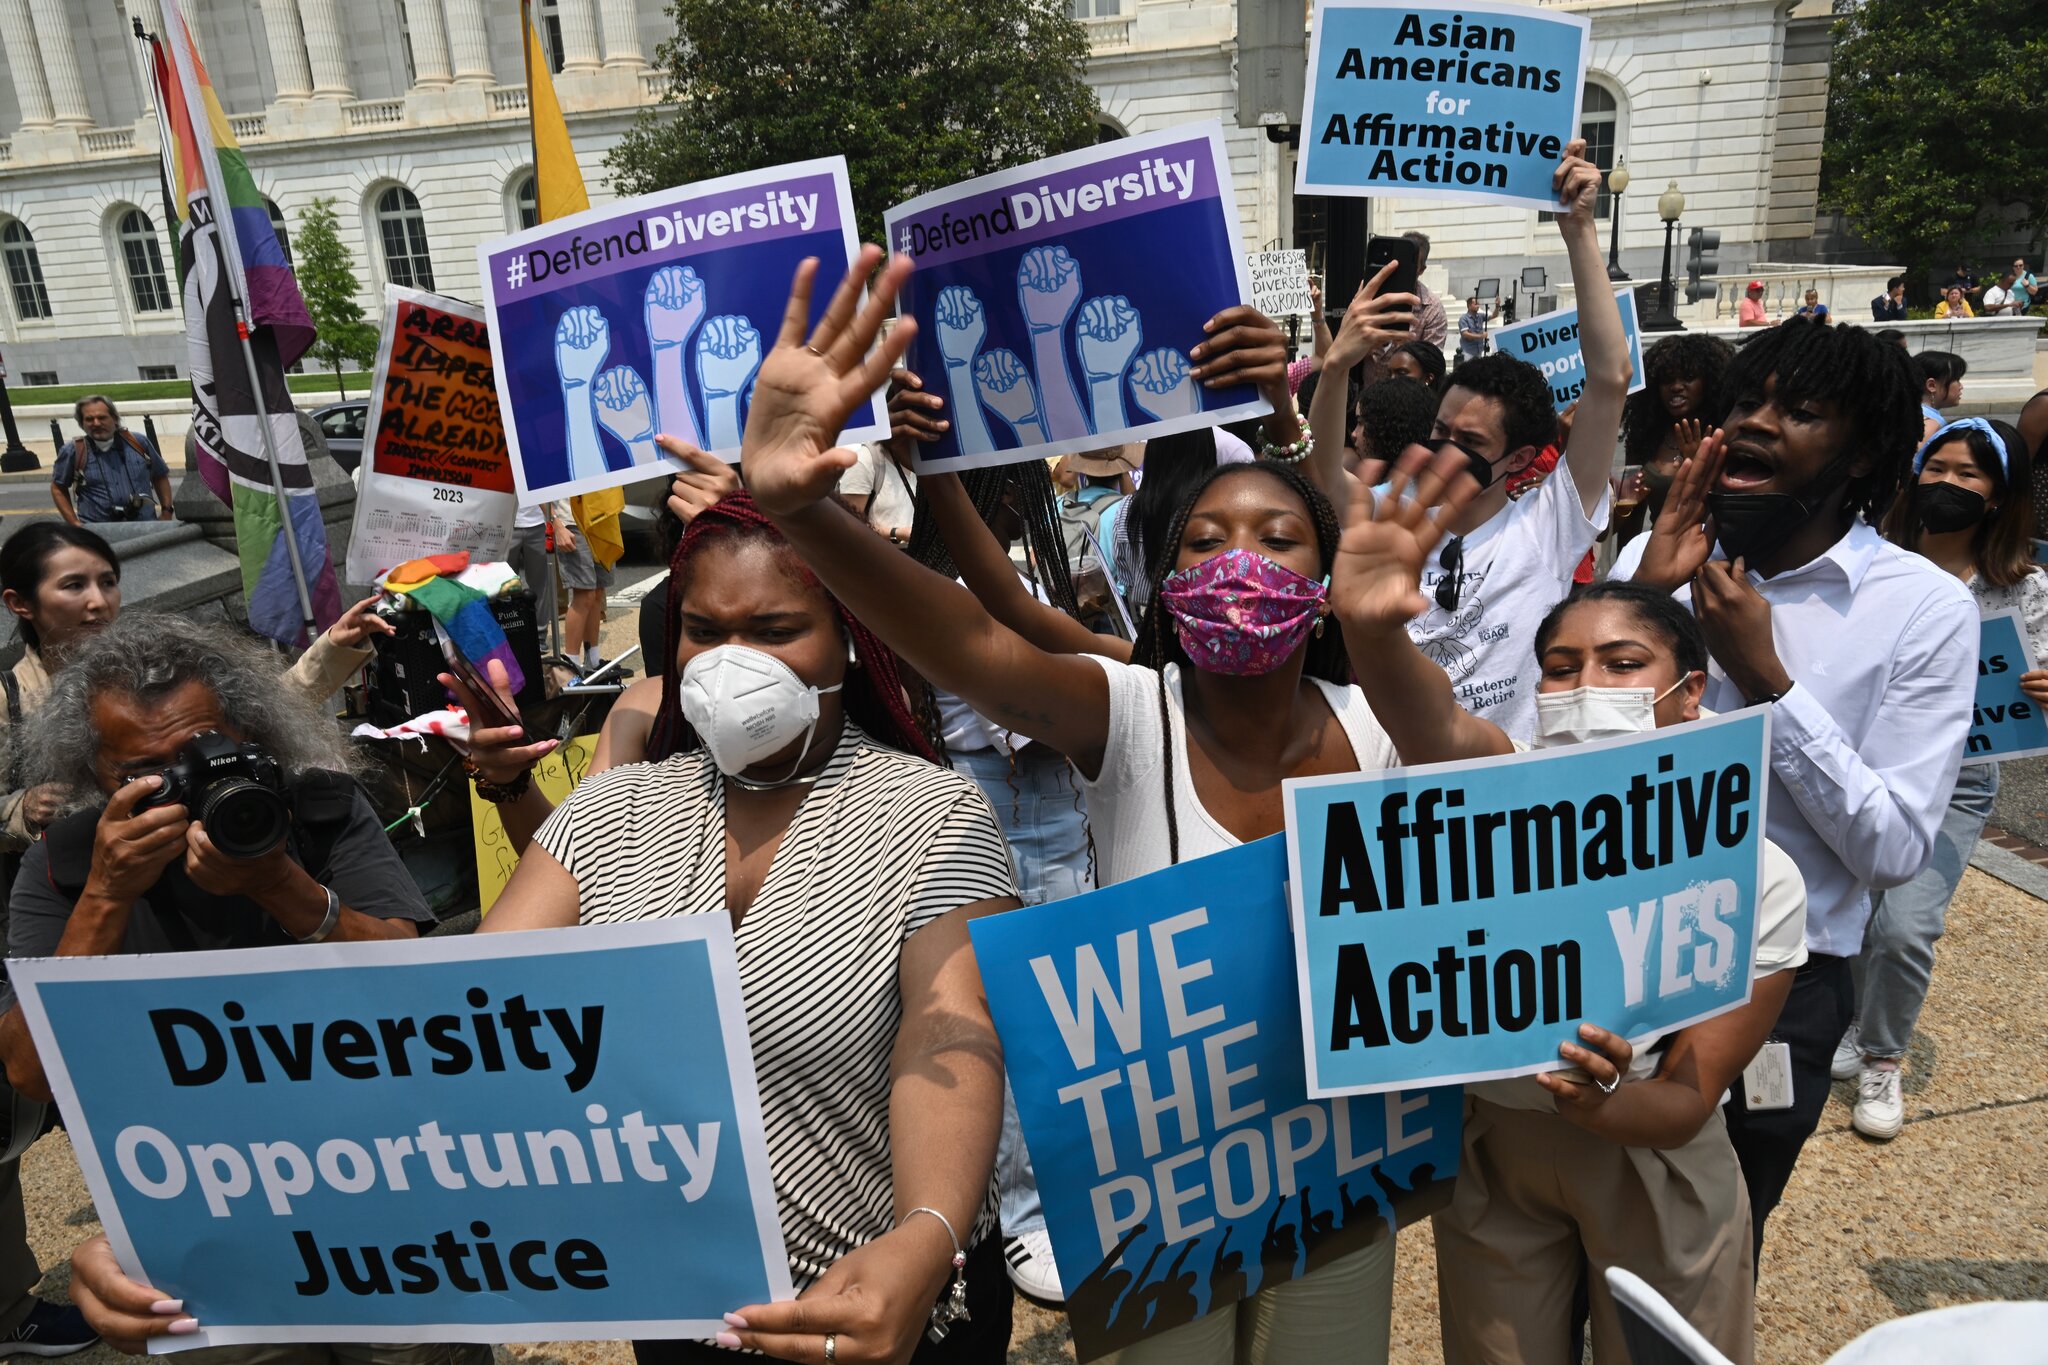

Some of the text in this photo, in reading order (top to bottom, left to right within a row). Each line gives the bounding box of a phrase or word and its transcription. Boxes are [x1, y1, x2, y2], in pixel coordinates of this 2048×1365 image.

[1394, 14, 1515, 52] Asian
[1336, 48, 1561, 93] Americans
[1426, 90, 1471, 116] for
[1321, 113, 1561, 160] Affirmative
[1368, 149, 1508, 188] Action
[900, 158, 1194, 257] #DefendDiversity
[507, 191, 818, 289] #DefendDiversity
[1253, 267, 1291, 280] SUPPORT
[1253, 276, 1302, 294] DIVERSE
[1521, 322, 1579, 354] Diver
[386, 376, 445, 411] THE
[383, 441, 502, 473] INDICT CONVICT
[406, 463, 472, 486] IMPRISON
[433, 487, 464, 503] 2023
[1484, 627, 1505, 641] GAO
[1461, 675, 1517, 698] Heteros
[1472, 689, 1516, 710] Retire
[210, 756, 237, 767] Nikon
[1319, 754, 1750, 916] Affirmative
[1330, 878, 1740, 1052] Action YES
[1029, 906, 1226, 1071] WE
[148, 987, 605, 1093] Diversity
[1057, 1020, 1265, 1176] THE
[115, 1103, 721, 1217] Opportunity
[1090, 1092, 1433, 1270] PEOPLE
[292, 1220, 610, 1296] Justice
